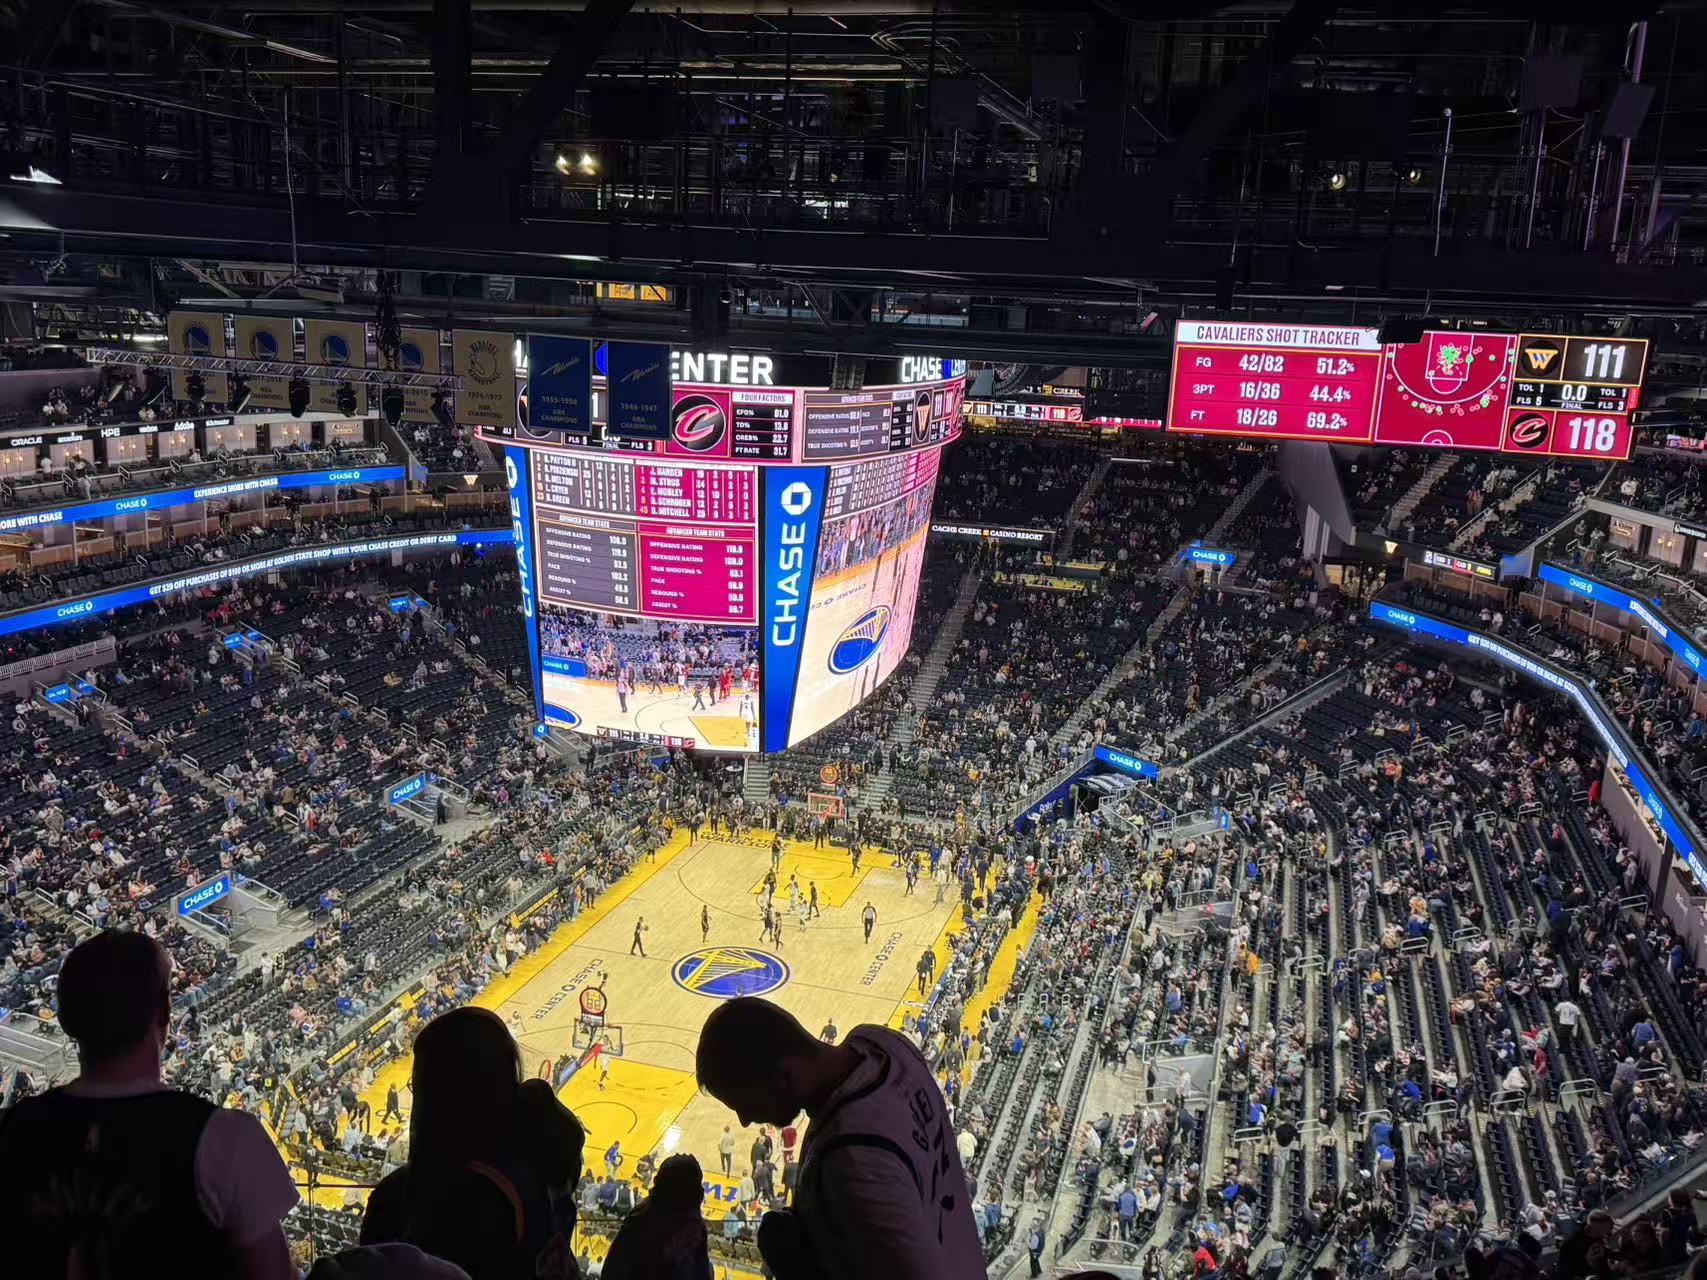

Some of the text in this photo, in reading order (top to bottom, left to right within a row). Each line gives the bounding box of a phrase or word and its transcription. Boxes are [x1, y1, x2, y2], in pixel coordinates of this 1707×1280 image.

[1197, 326, 1359, 345] CAVALIERS SHOT TRACKER
[1196, 354, 1354, 375] FG 42/82 51.2%
[1584, 344, 1626, 378] 111
[902, 356, 942, 383] CHASE
[469, 392, 502, 400] 1974-1975
[758, 394, 785, 402] FACTORS
[1193, 381, 1351, 402] 3PT 16/36 44.4%
[1519, 384, 1534, 392] TOL
[1540, 384, 1544, 393] 1
[1562, 385, 1587, 401] 0.0
[1622, 389, 1626, 398] 1
[1618, 402, 1623, 411] 3
[468, 410, 502, 419] CHAMPIONS
[1191, 408, 1347, 429] FT 18/26 69.2%
[101, 428, 120, 437] HPE
[174, 422, 194, 431] Adobe
[1569, 417, 1616, 451] 118
[12, 437, 42, 446] ORACLE
[773, 434, 788, 443] 22.7
[774, 447, 787, 456] 31.7
[194, 478, 278, 498] EXPERIENCE MORE WITH CHASE
[116, 501, 139, 510] CHASE
[0, 512, 62, 530] ORE WITH CHASE
[546, 527, 571, 536] OFFENSIVE
[932, 525, 1043, 540] CACHE CREEK CASINO RESORT
[547, 539, 571, 548] DEFENSIVE
[511, 499, 532, 618] CHASE
[560, 553, 585, 562] SHOOTING
[1193, 551, 1218, 559] CHASE
[149, 586, 162, 595] GET
[162, 583, 173, 592] $20
[174, 580, 185, 589] OFF
[186, 572, 219, 586] PURCHASES
[220, 570, 227, 579] OF
[228, 567, 241, 576] $100
[242, 565, 250, 573] OR
[250, 562, 266, 572] MORE
[274, 556, 294, 565] GOLDEN
[295, 552, 313, 560] STATE
[314, 549, 331, 558] SHOP
[332, 547, 349, 555] WITH
[350, 544, 367, 553] YOUR
[369, 542, 388, 551] CHASE
[389, 539, 409, 548] CREDIT
[548, 575, 571, 584] REBOUND
[772, 522, 806, 646] CHASE
[1570, 578, 1587, 591] CHASE
[57, 605, 84, 617] CHASE
[1388, 610, 1408, 622] CHASE
[1110, 753, 1133, 769] CHASE
[393, 783, 414, 798] CHASE
[184, 887, 214, 910] CHASE
[569, 959, 603, 984] CHASE
[859, 962, 883, 986] CENTER
[531, 992, 567, 1020] CENTER
